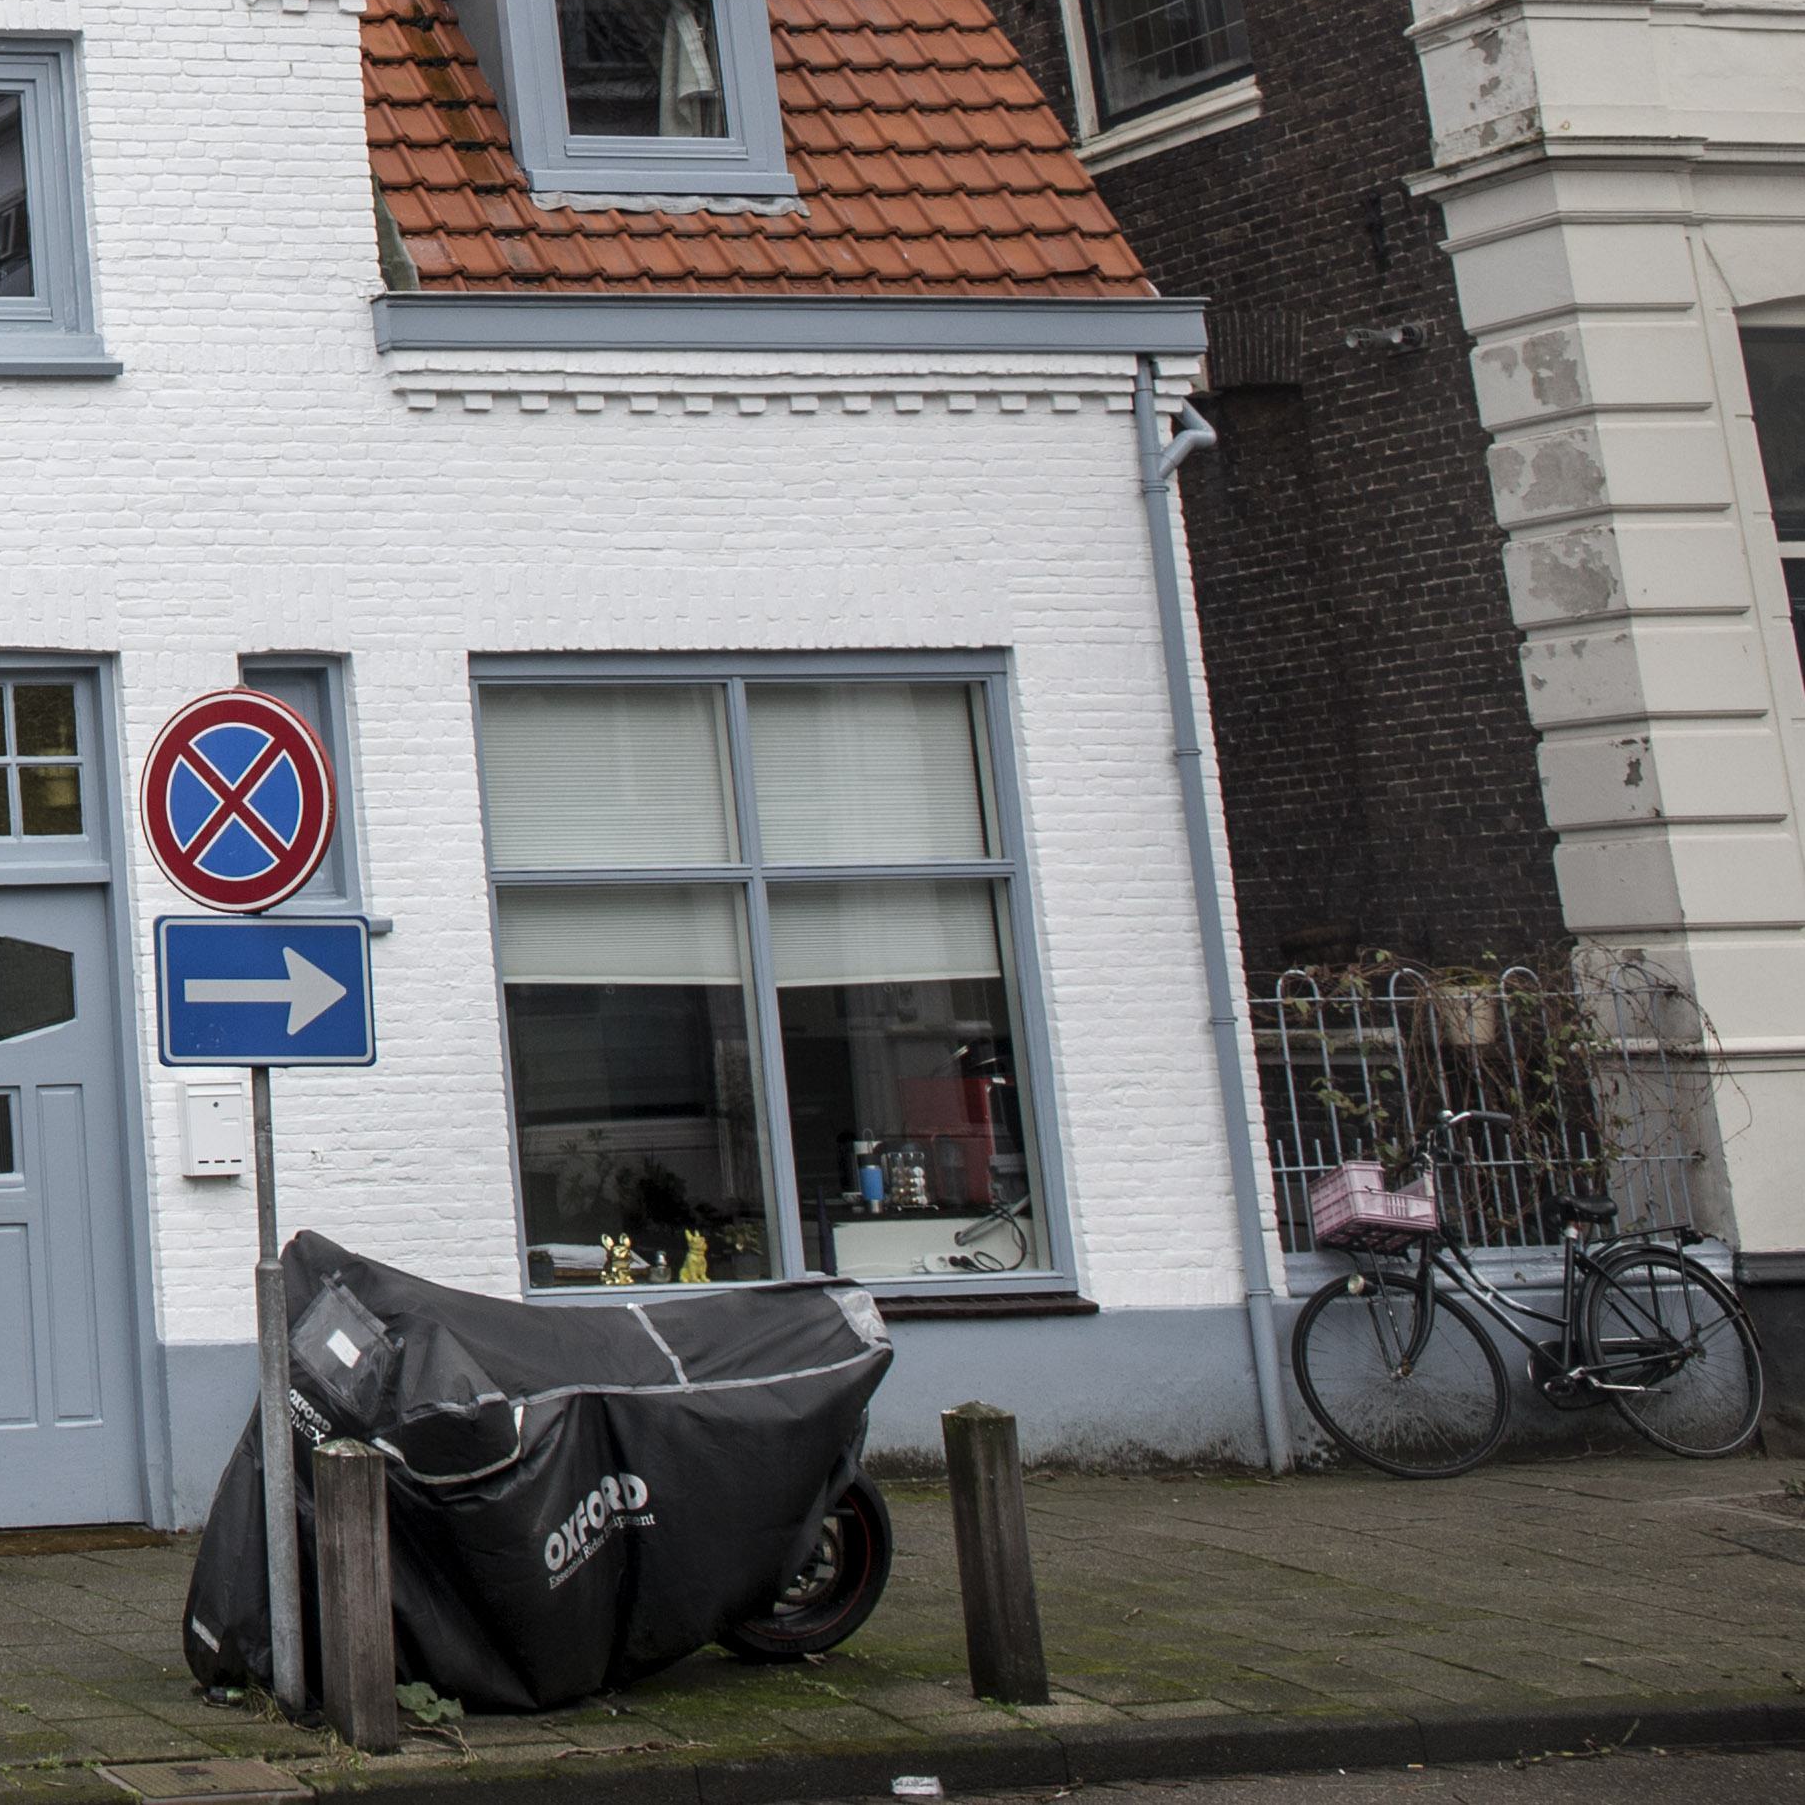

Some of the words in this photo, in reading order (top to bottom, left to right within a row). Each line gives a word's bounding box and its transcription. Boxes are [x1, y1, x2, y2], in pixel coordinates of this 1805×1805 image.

[290, 1389, 331, 1432] OXFORD
[290, 1407, 325, 1445] MEX
[544, 1473, 648, 1571] OXFORD
[582, 1534, 605, 1560] Rider
